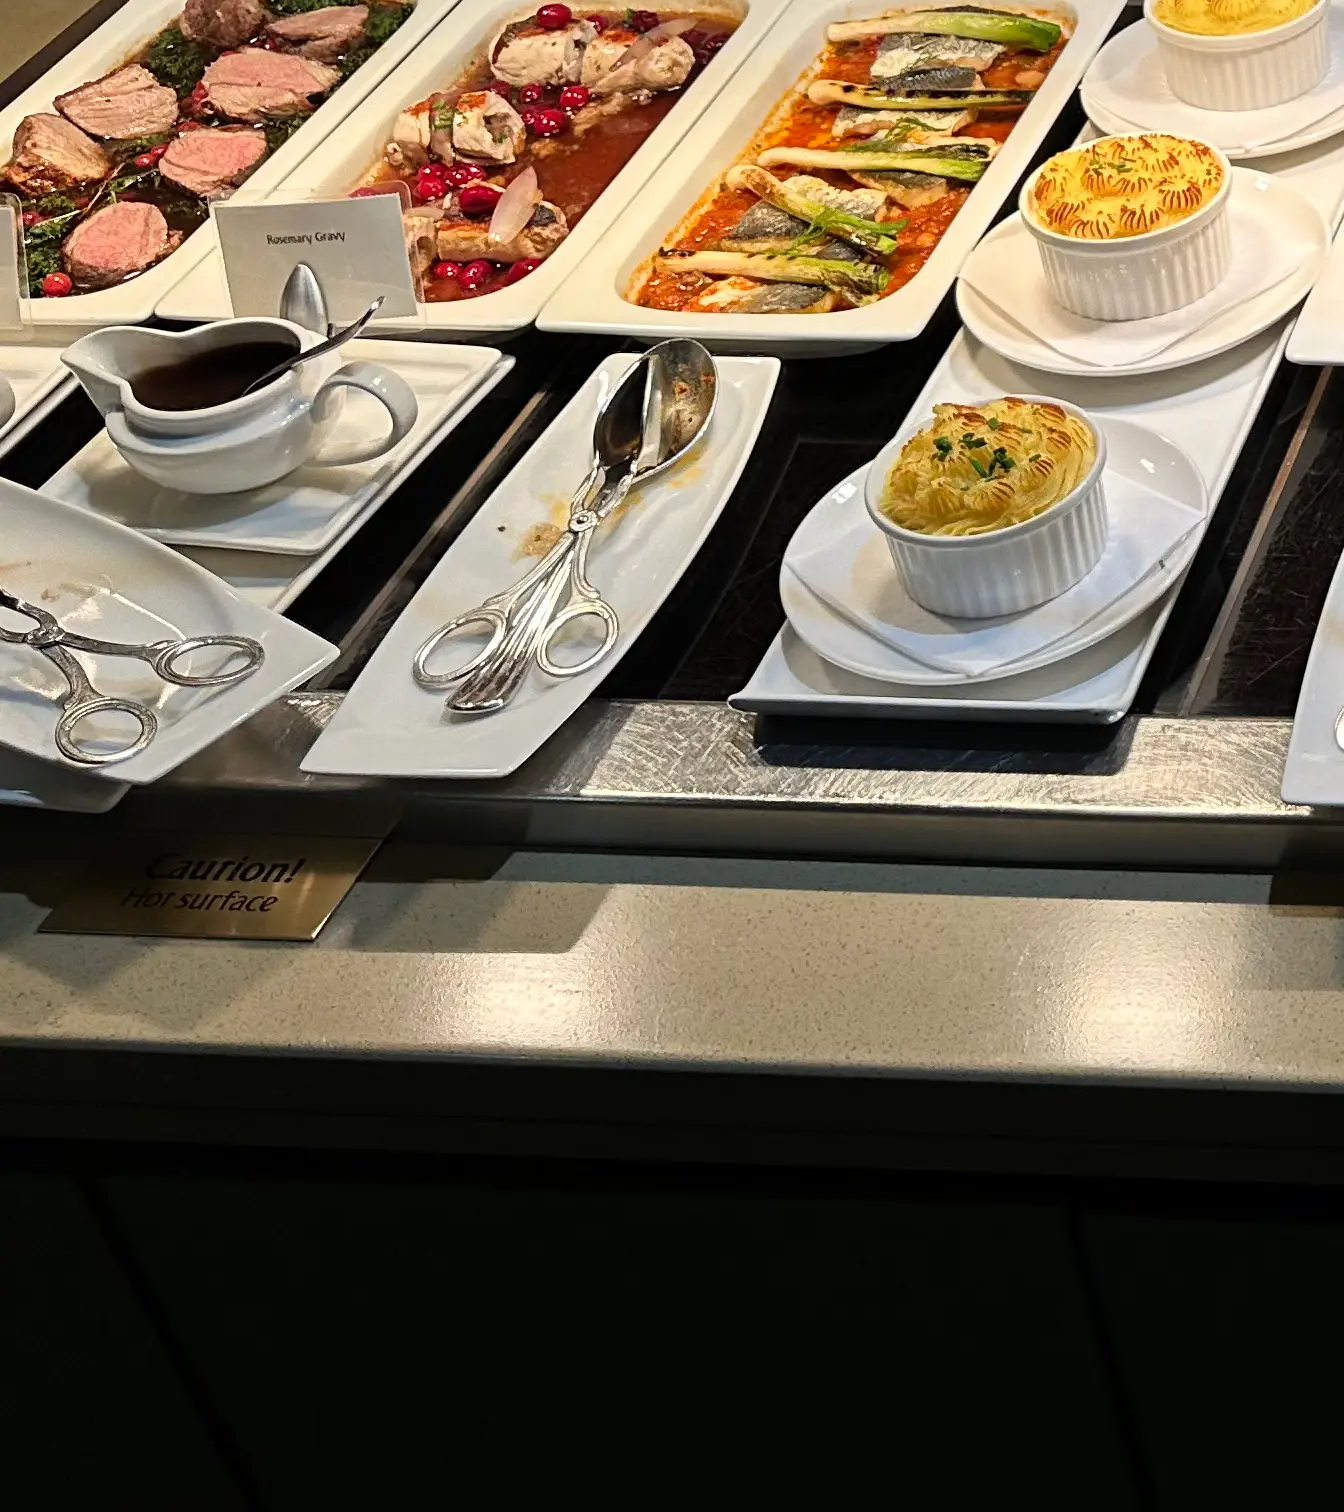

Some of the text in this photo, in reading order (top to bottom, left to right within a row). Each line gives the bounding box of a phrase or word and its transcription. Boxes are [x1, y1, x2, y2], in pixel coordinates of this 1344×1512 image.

[266, 230, 346, 246] Rosemary Gravy
[146, 853, 306, 884] Caution!
[120, 886, 279, 913] Hot surface
